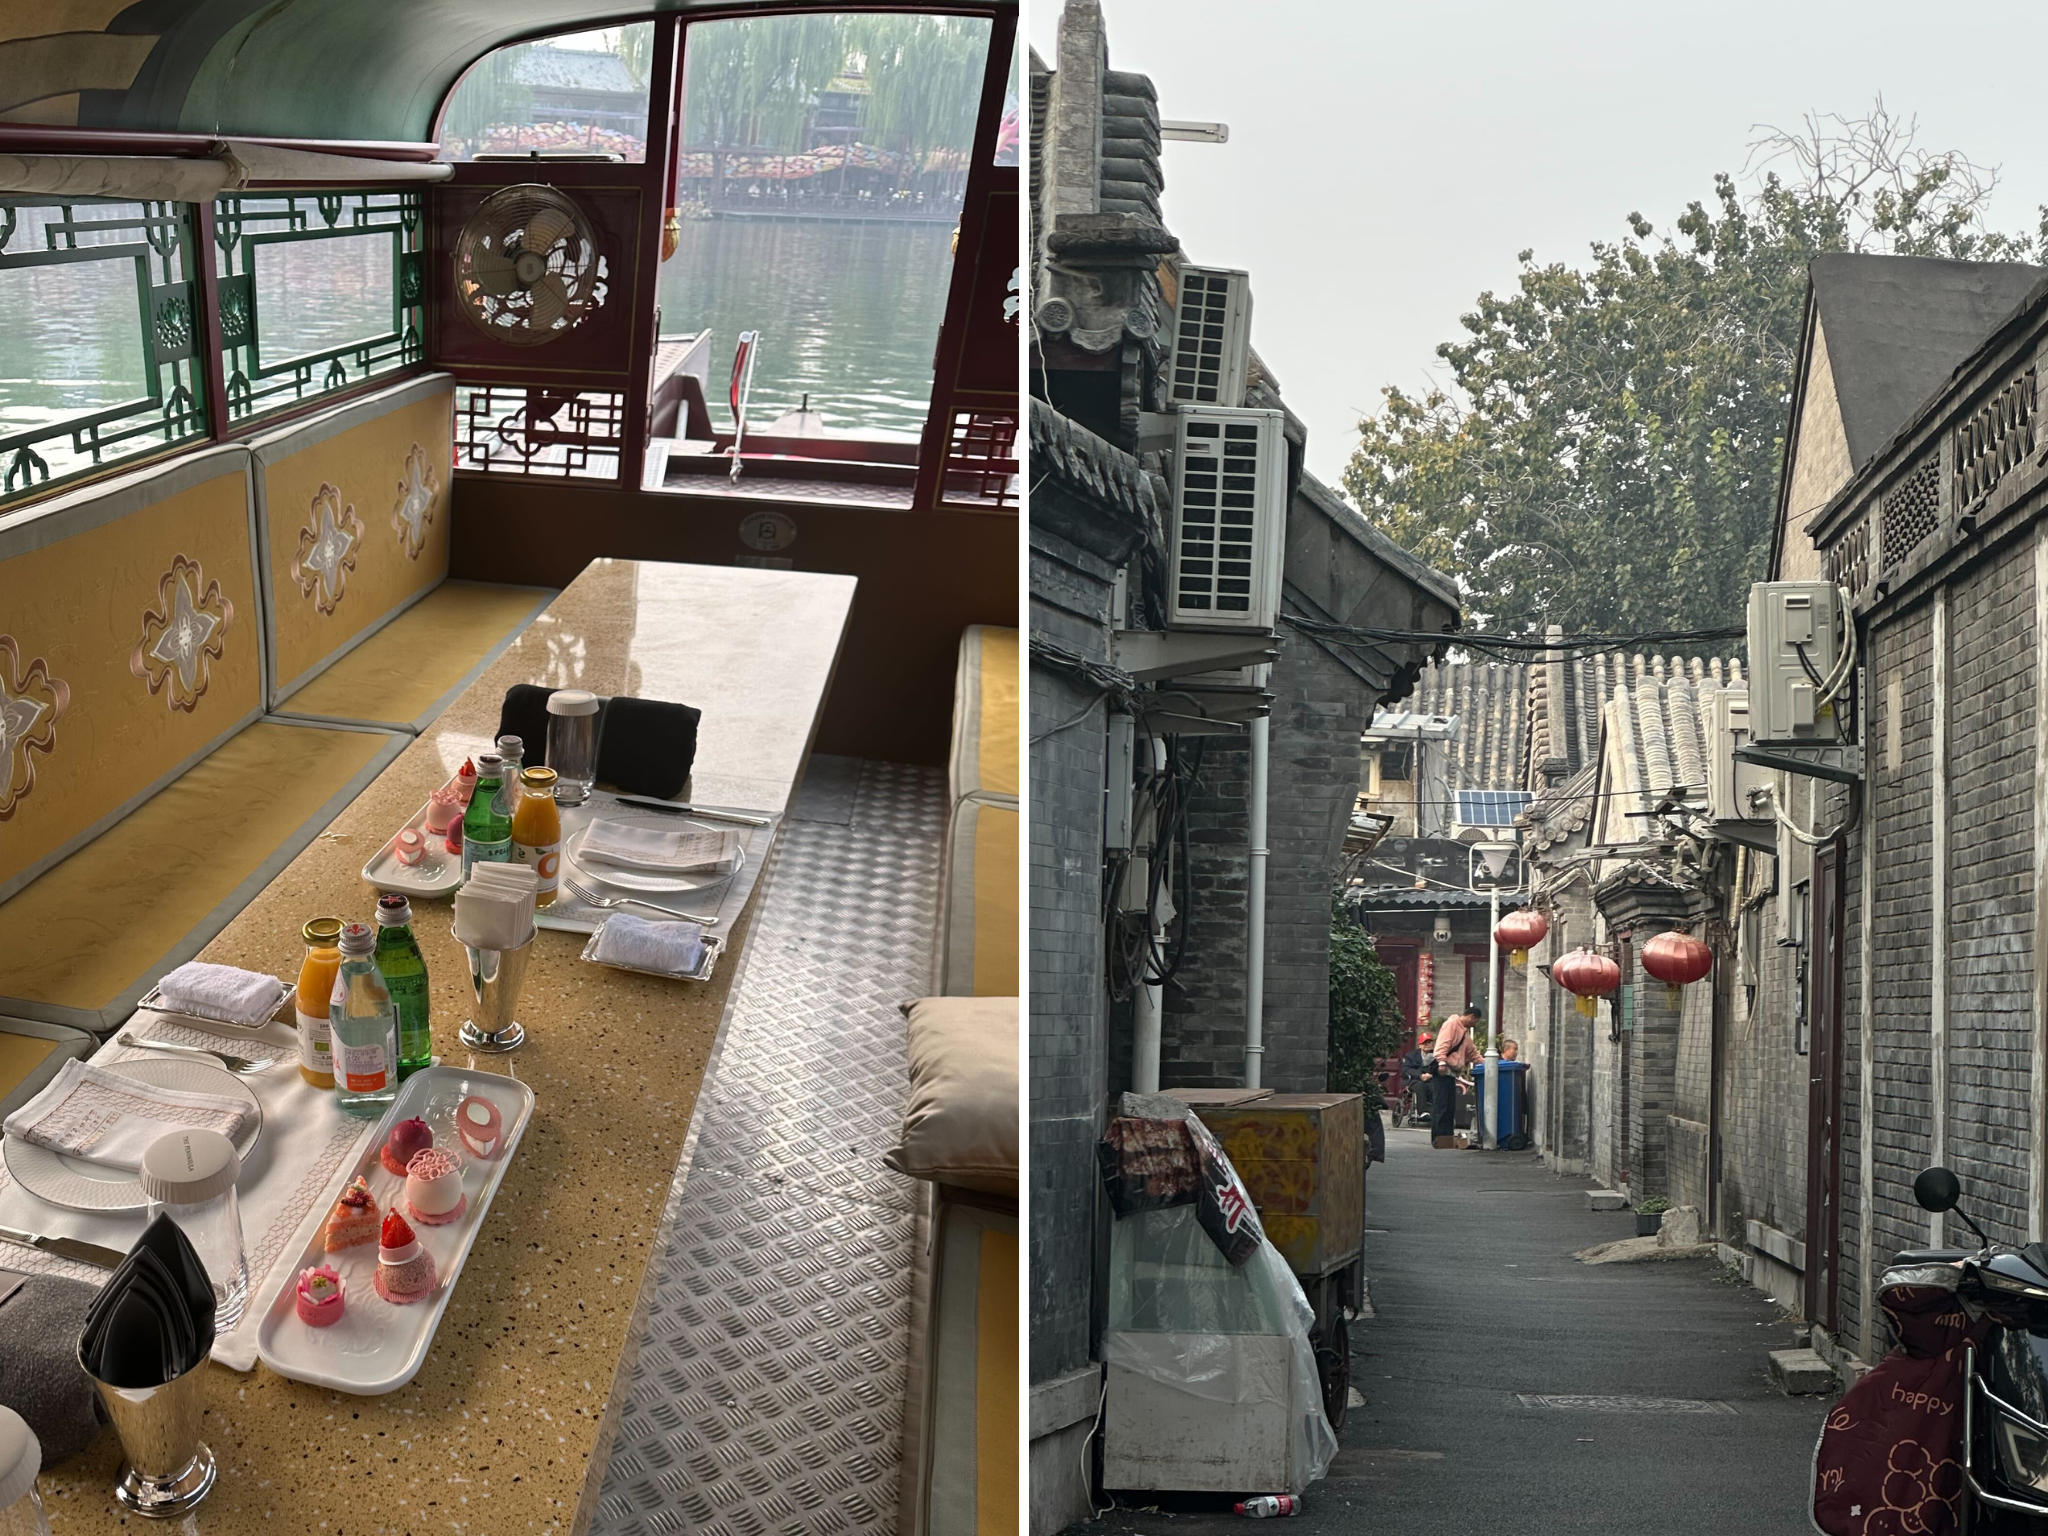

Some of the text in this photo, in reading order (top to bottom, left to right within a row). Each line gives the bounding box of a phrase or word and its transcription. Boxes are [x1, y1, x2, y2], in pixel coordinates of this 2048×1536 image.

[182, 1135, 195, 1173] THE PENINSULA
[1891, 1381, 1954, 1416] happy
